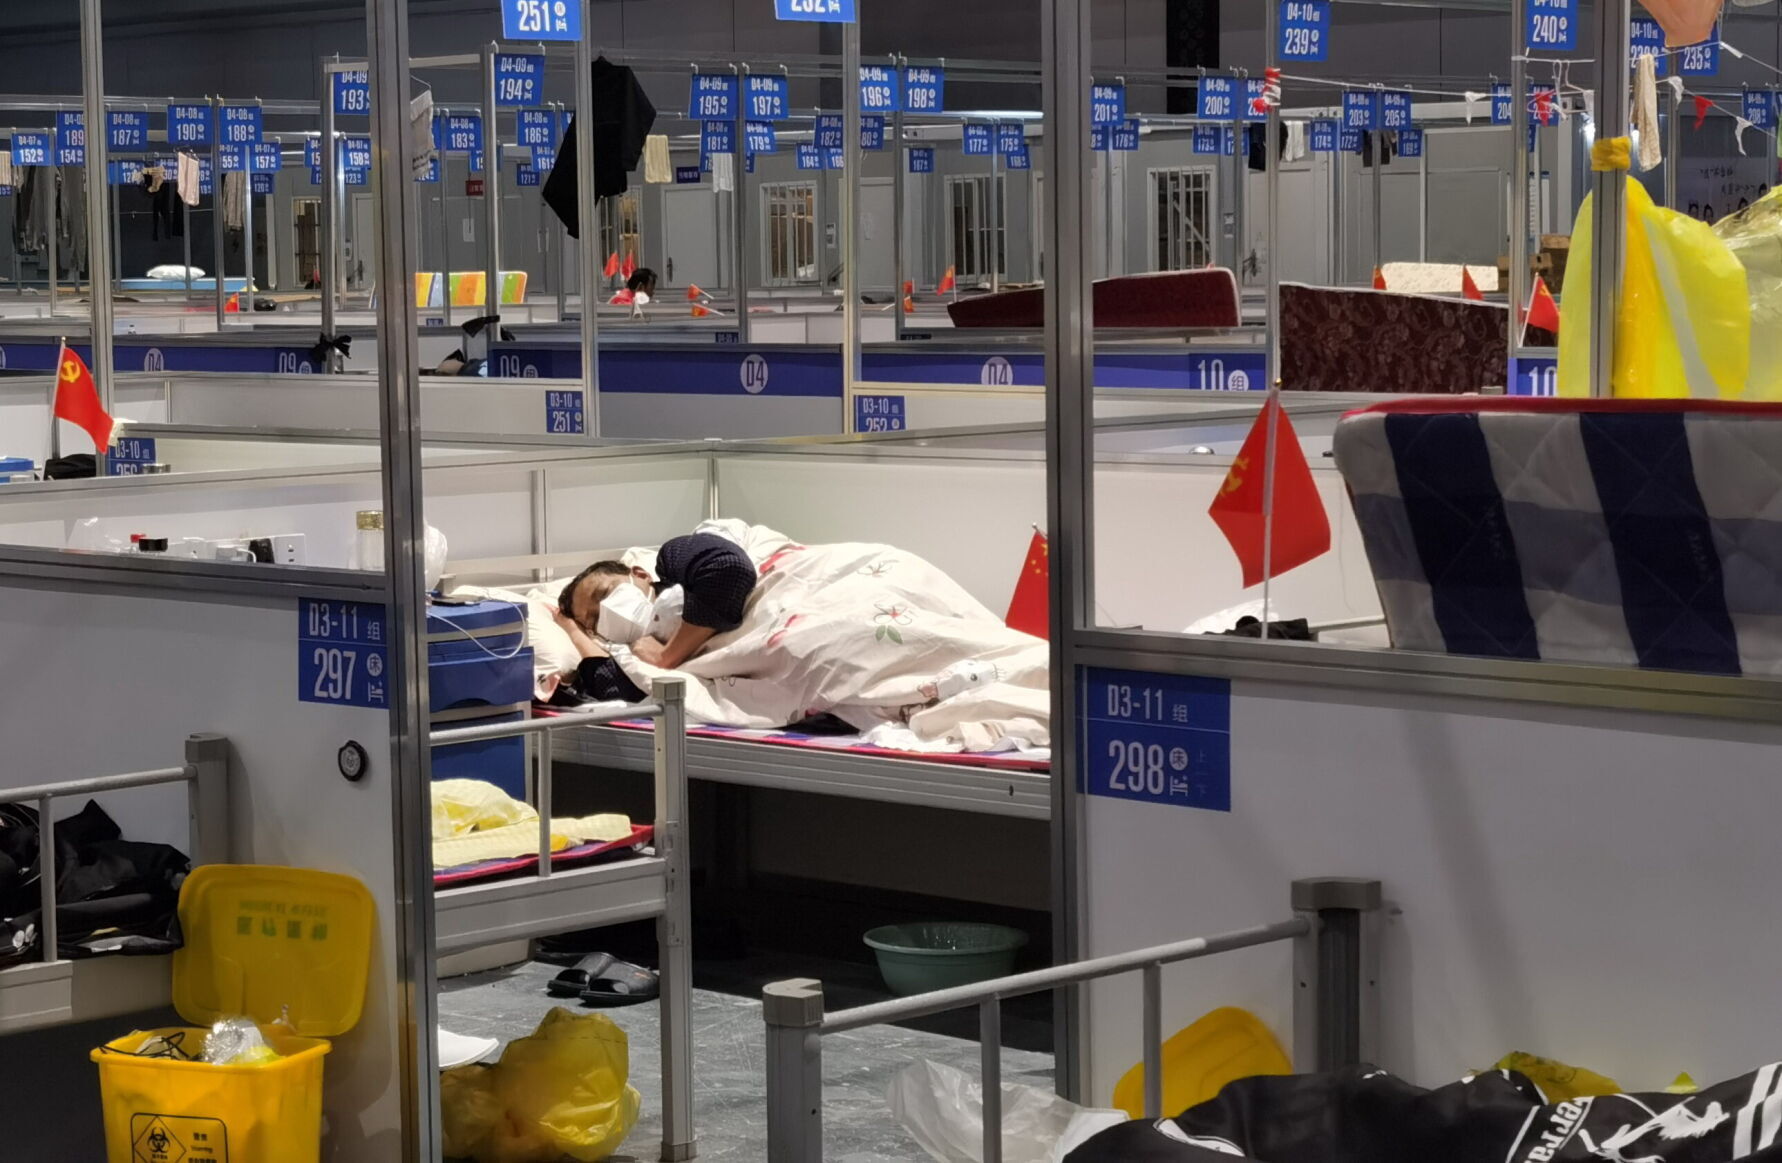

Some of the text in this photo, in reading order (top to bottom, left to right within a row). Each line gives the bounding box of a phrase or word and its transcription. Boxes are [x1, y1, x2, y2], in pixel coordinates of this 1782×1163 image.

[517, 0, 551, 32] 251
[1532, 15, 1557, 43] 240
[1284, 28, 1309, 55] 239
[1683, 46, 1703, 70] 235
[499, 78, 523, 101] 194
[862, 86, 883, 107] 196
[907, 87, 928, 108] 198
[341, 89, 364, 110] 193
[699, 95, 720, 115] 195
[752, 95, 773, 115] 197
[1205, 95, 1223, 115] 200
[1094, 103, 1110, 122] 201
[1349, 109, 1364, 126] 203
[1384, 109, 1400, 127] 205
[65, 129, 84, 146] 189
[112, 129, 132, 145] 187
[176, 123, 196, 141] 190
[227, 124, 247, 141] 188
[451, 132, 468, 149] 183
[524, 127, 542, 143] 186
[820, 131, 835, 146] 182
[707, 136, 721, 150] 181
[748, 136, 765, 150] 179
[969, 138, 982, 153] 177
[1000, 138, 1014, 152] 175
[20, 148, 37, 163] 152
[60, 149, 76, 163] 154
[255, 156, 270, 168] 157
[537, 157, 550, 170] 161
[279, 351, 297, 373] 09
[500, 355, 520, 378] 09
[552, 410, 571, 433] 251
[313, 647, 357, 700] 297
[1107, 683, 1163, 721] D3-11
[1108, 739, 1165, 795] 298
